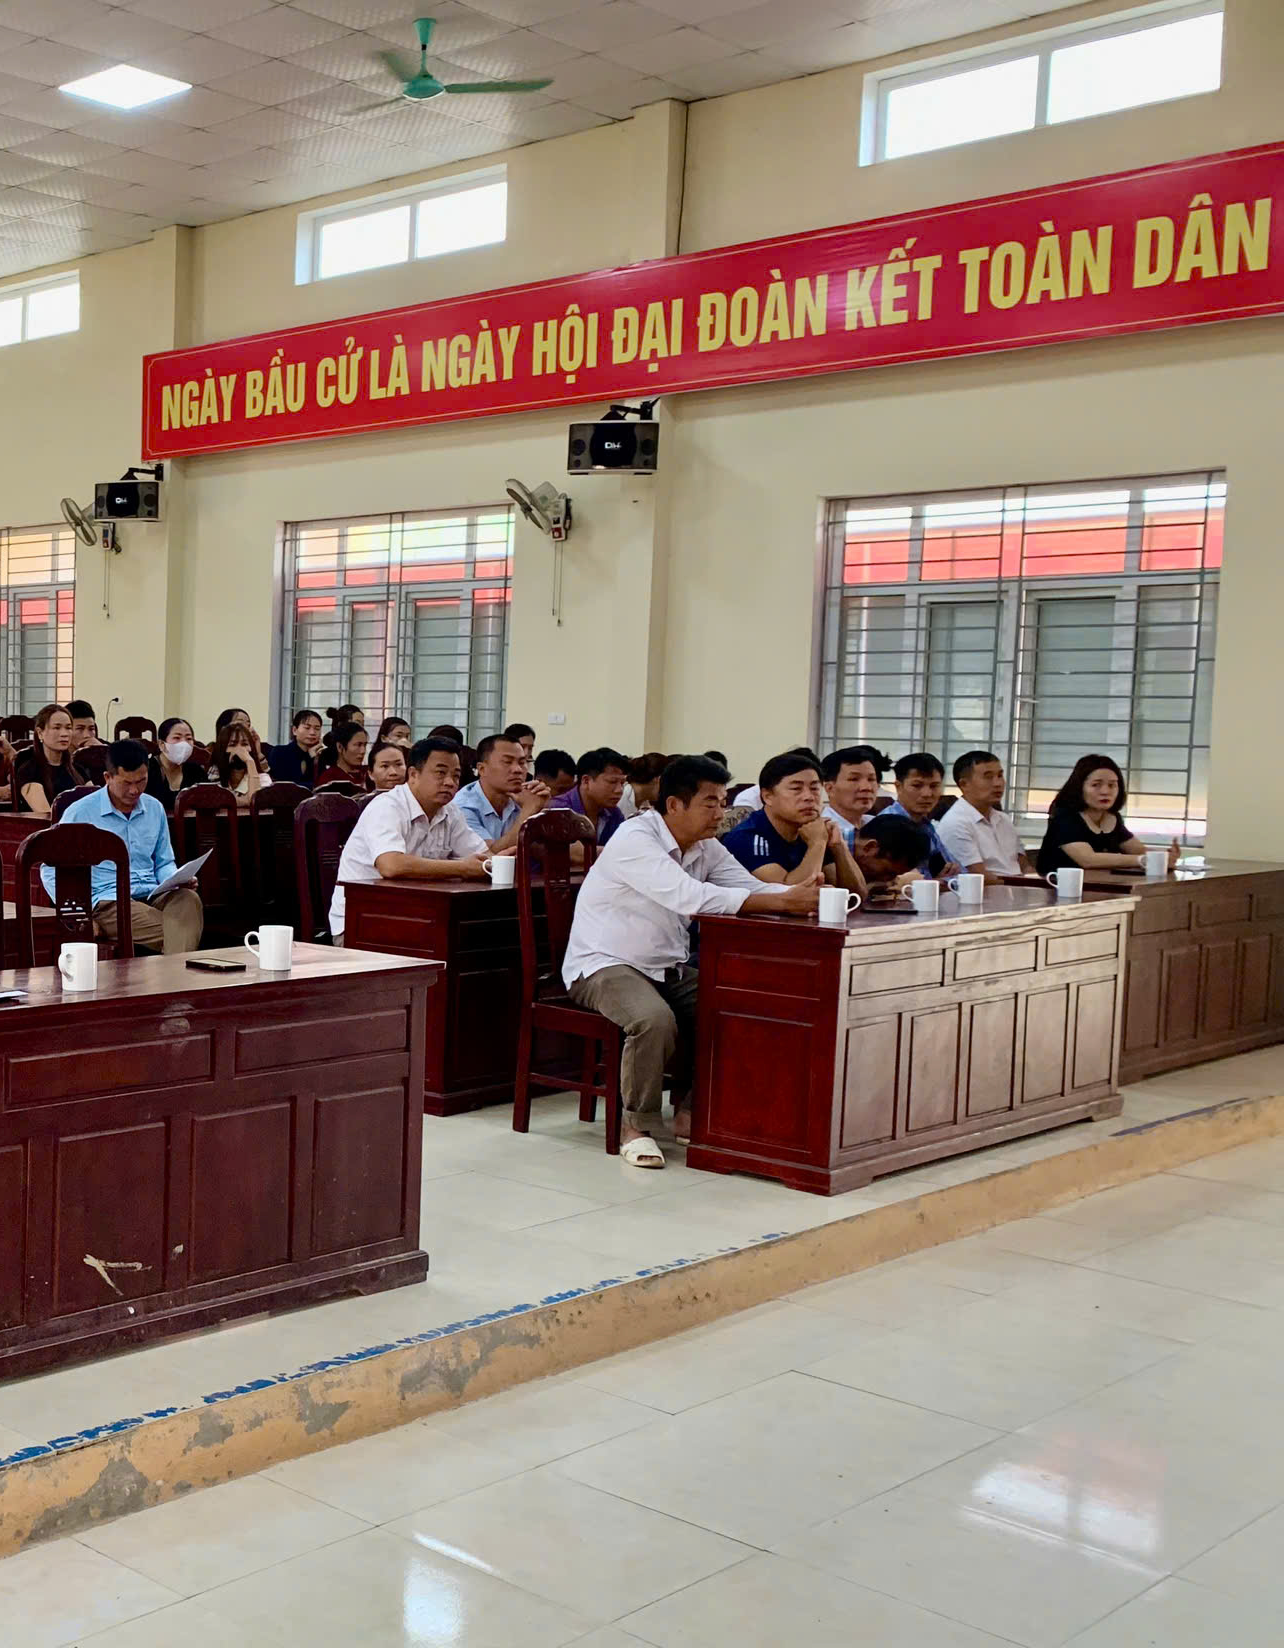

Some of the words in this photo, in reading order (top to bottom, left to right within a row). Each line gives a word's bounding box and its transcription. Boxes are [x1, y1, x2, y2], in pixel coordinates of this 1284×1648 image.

[161, 368, 237, 431] NGÀY
[245, 348, 306, 419] BẦU
[316, 336, 364, 408] CỬ
[369, 334, 410, 400] LÀ
[421, 319, 521, 393] NGÀY
[531, 304, 599, 385] HỘI
[611, 298, 684, 373] ĐẠI
[697, 268, 829, 353] ĐOÀN
[845, 237, 942, 331] KẾT
[959, 220, 1114, 314] TOÀN
[1132, 192, 1273, 289] DÂN
